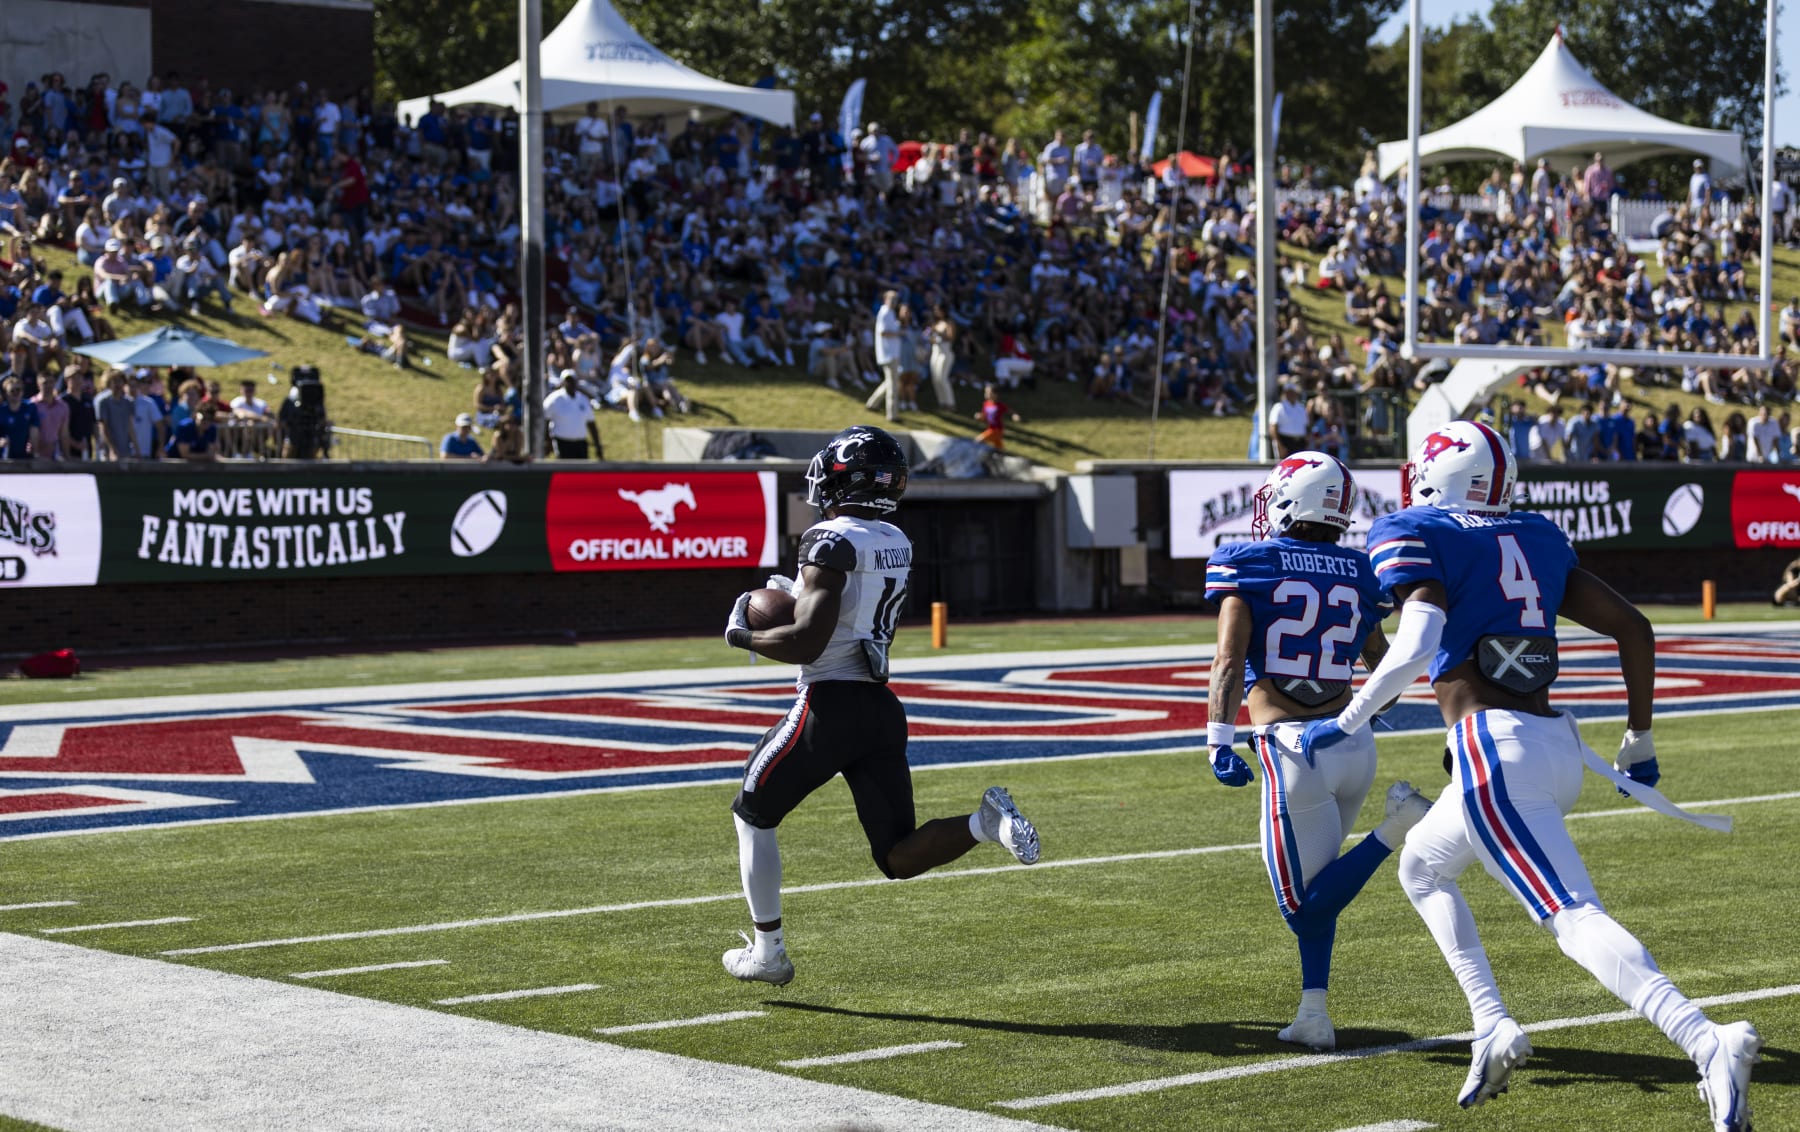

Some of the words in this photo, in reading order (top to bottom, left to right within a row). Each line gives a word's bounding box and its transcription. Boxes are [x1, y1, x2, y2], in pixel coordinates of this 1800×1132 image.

[173, 489, 253, 517] MOVE
[256, 488, 330, 516] WITH
[335, 487, 373, 515] US
[1528, 481, 1580, 504] WITH
[1582, 481, 1610, 503] US
[138, 511, 406, 569] FANTASTICALLY
[569, 539, 670, 561] OFFICIAL
[672, 536, 748, 559] MOVER
[1279, 551, 1358, 578] ROBERTS
[1496, 533, 1547, 629] 4
[1264, 578, 1362, 681] 22
